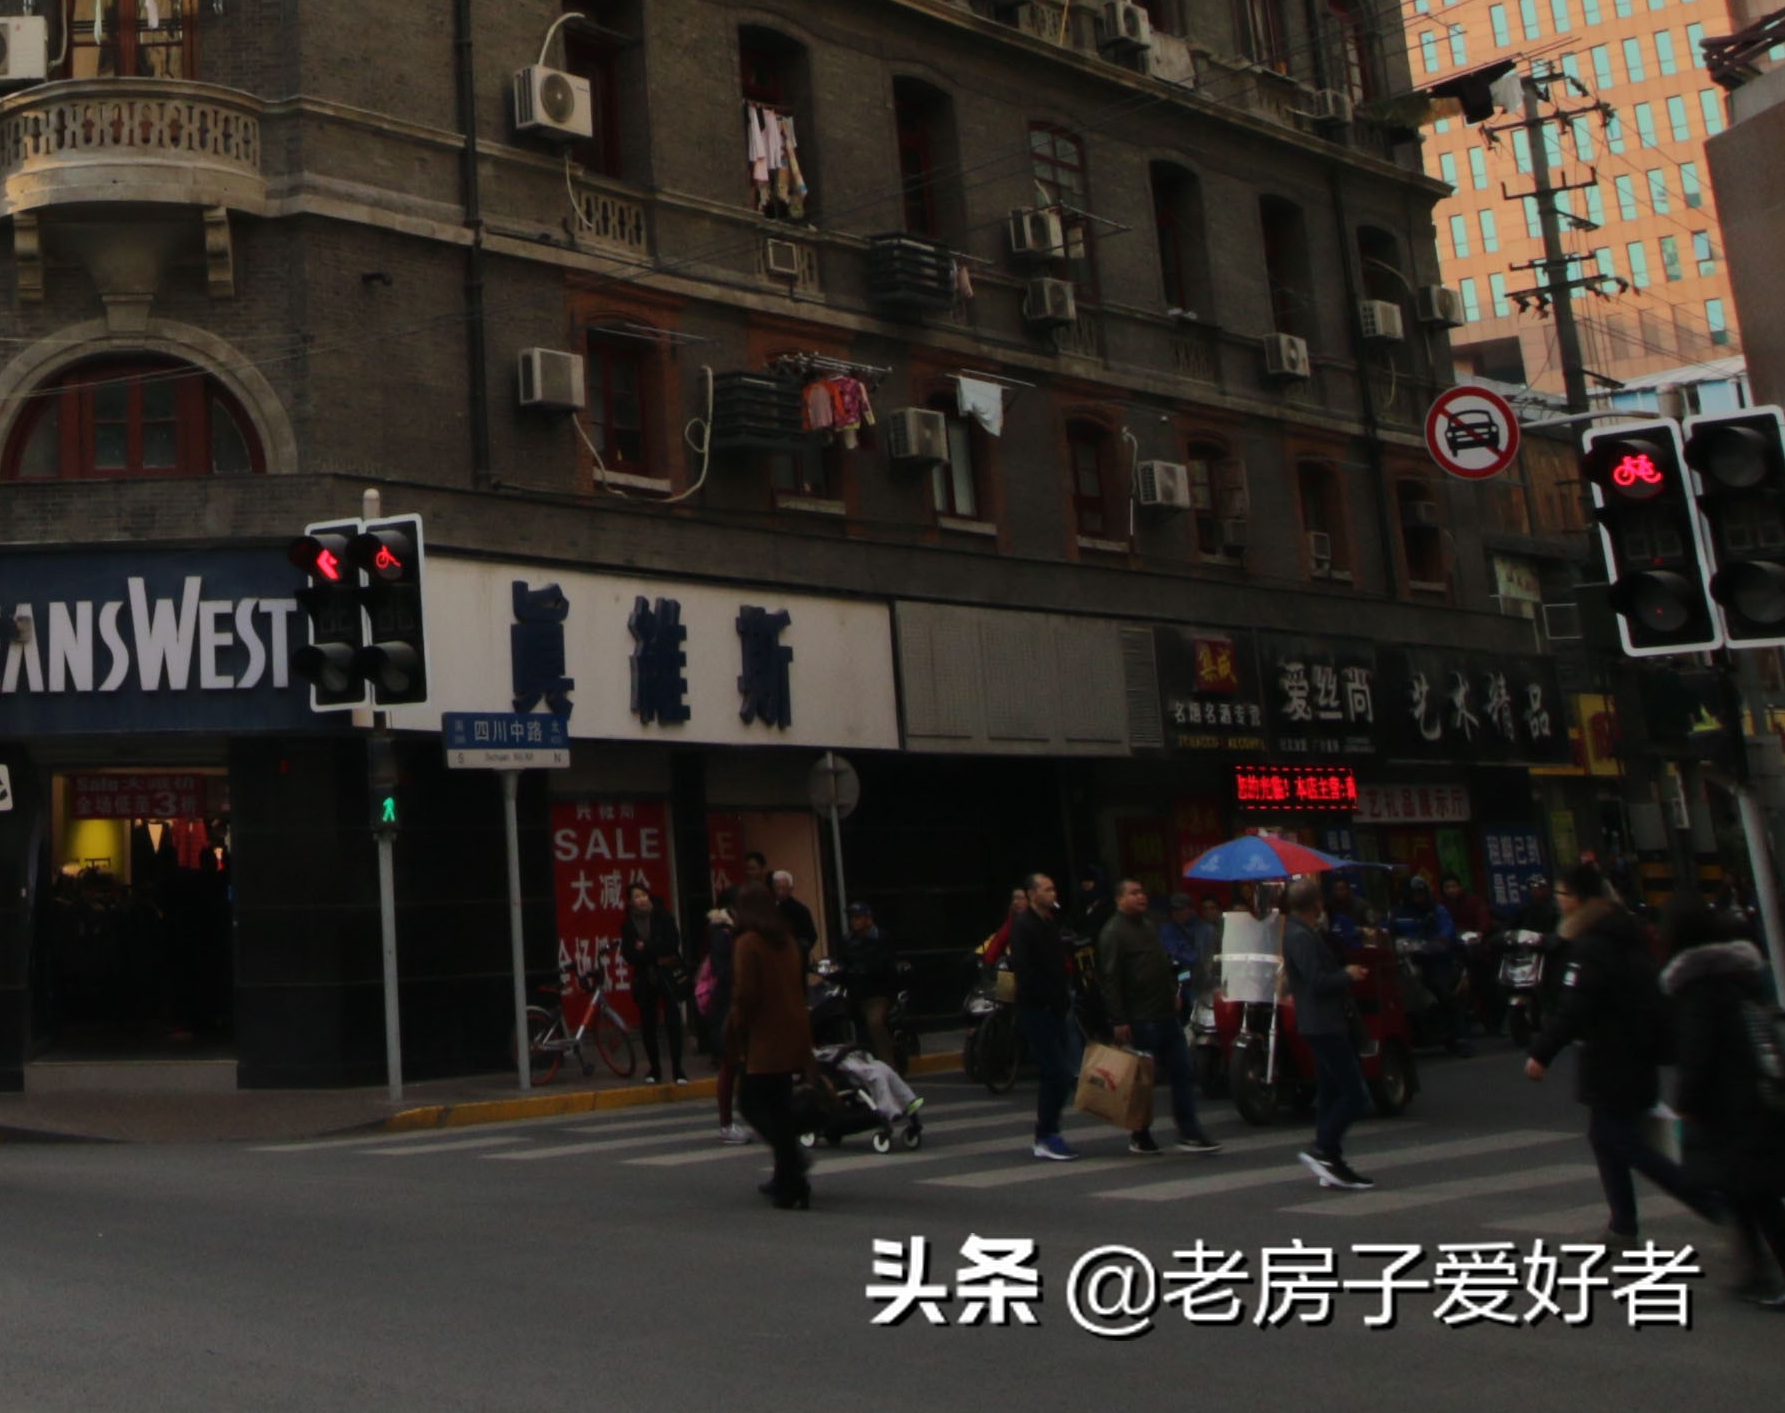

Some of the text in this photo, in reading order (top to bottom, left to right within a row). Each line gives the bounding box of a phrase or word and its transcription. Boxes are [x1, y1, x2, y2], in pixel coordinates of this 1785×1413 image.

[1279, 660, 1374, 724] 爱丝尚
[1409, 668, 1553, 746] 艺术精品
[473, 719, 543, 743] 四川中路
[553, 827, 661, 862] SALE
